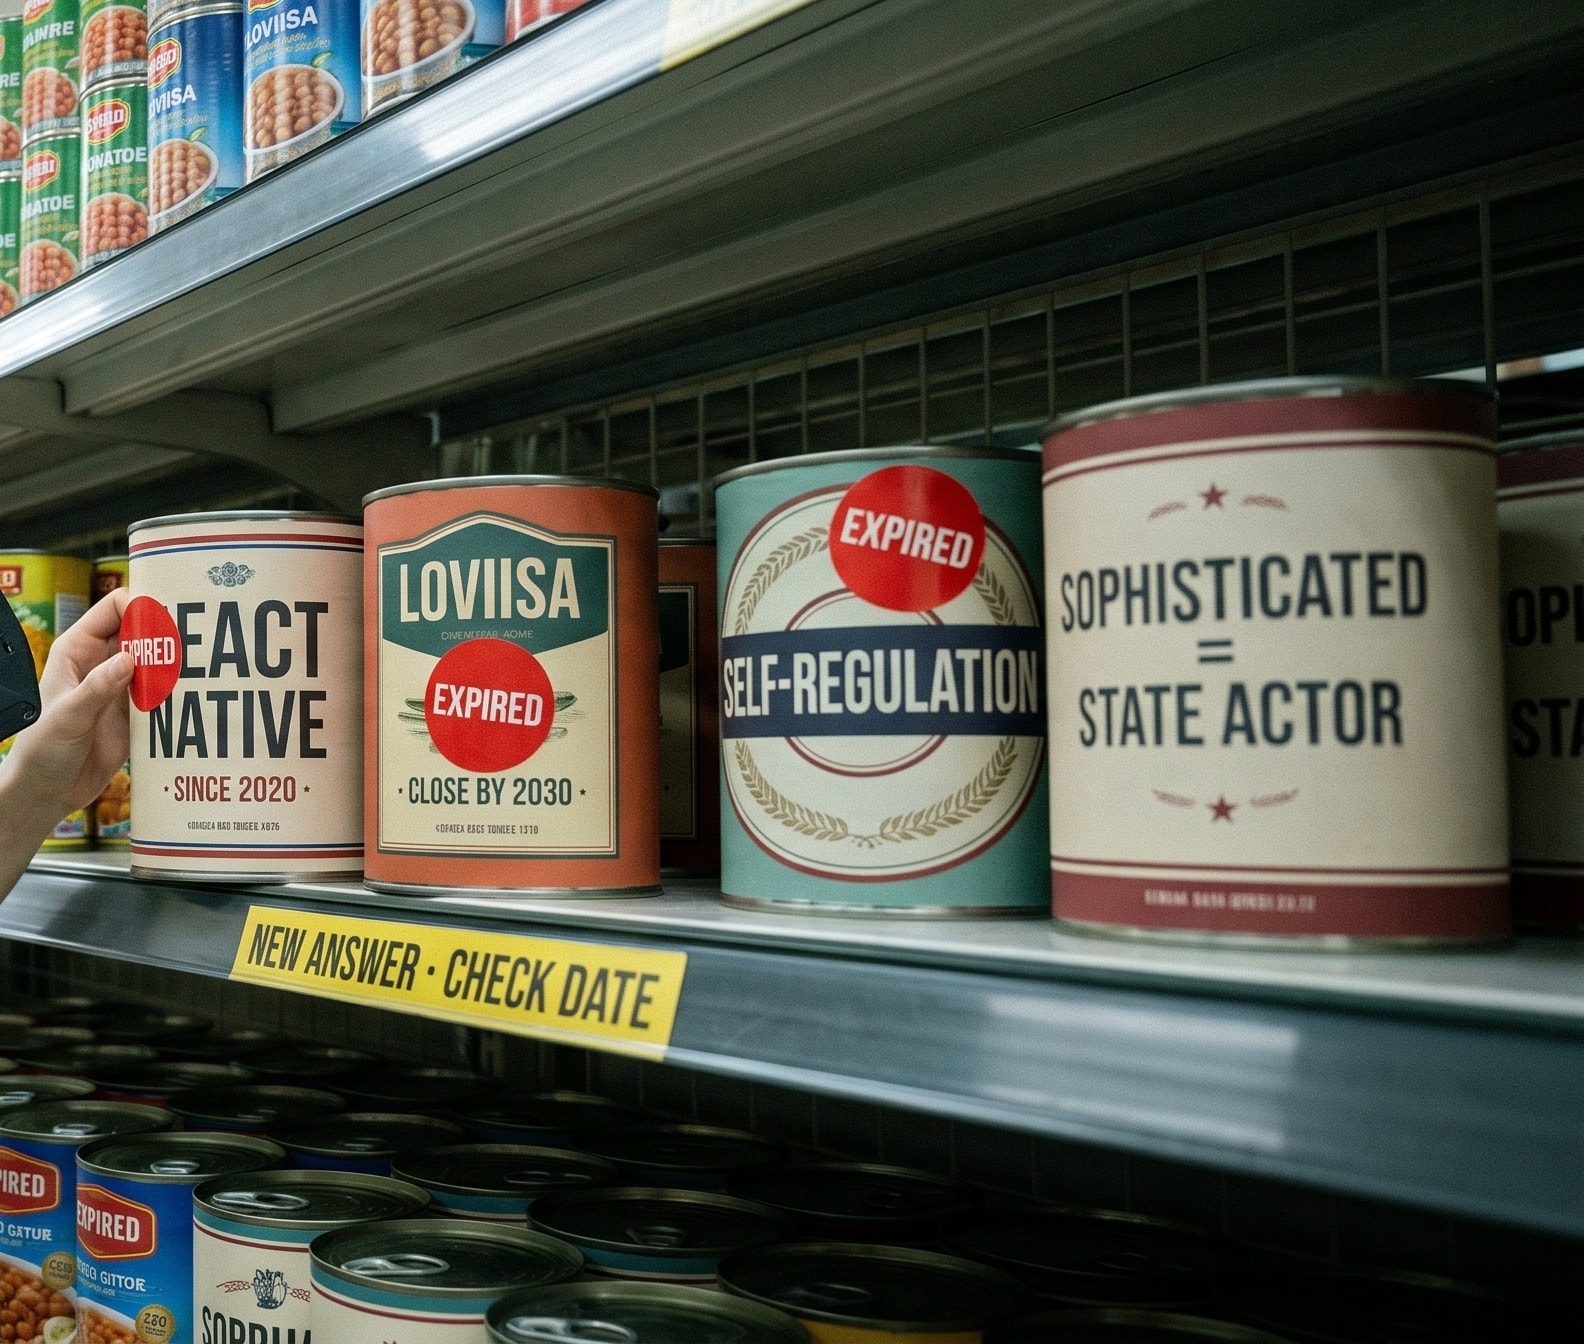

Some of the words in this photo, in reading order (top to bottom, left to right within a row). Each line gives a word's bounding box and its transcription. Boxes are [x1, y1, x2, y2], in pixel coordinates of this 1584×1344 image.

[245, 6, 318, 50] LOVIISA
[839, 507, 974, 569] EXPIRED
[400, 557, 581, 622] LOVIISA
[1061, 552, 1429, 632] SOPHISTICATED
[176, 599, 329, 679] EACT
[433, 683, 543, 727] EXPIRED
[723, 649, 1038, 718] SELF-REGULATION
[1079, 683, 1204, 748] STATE
[1222, 680, 1403, 746] ACTOR
[149, 690, 327, 759] NATIVE
[174, 775, 232, 802] SINCE
[239, 775, 296, 803] 2020
[408, 776, 469, 805] CLOSE
[476, 777, 506, 805] BY
[513, 777, 572, 806] 2030
[247, 923, 307, 972] NEW
[304, 931, 421, 991] ANSWER
[443, 949, 556, 1013] CHECK
[558, 964, 660, 1029] DATE
[77, 1200, 140, 1243] EXPIRED
